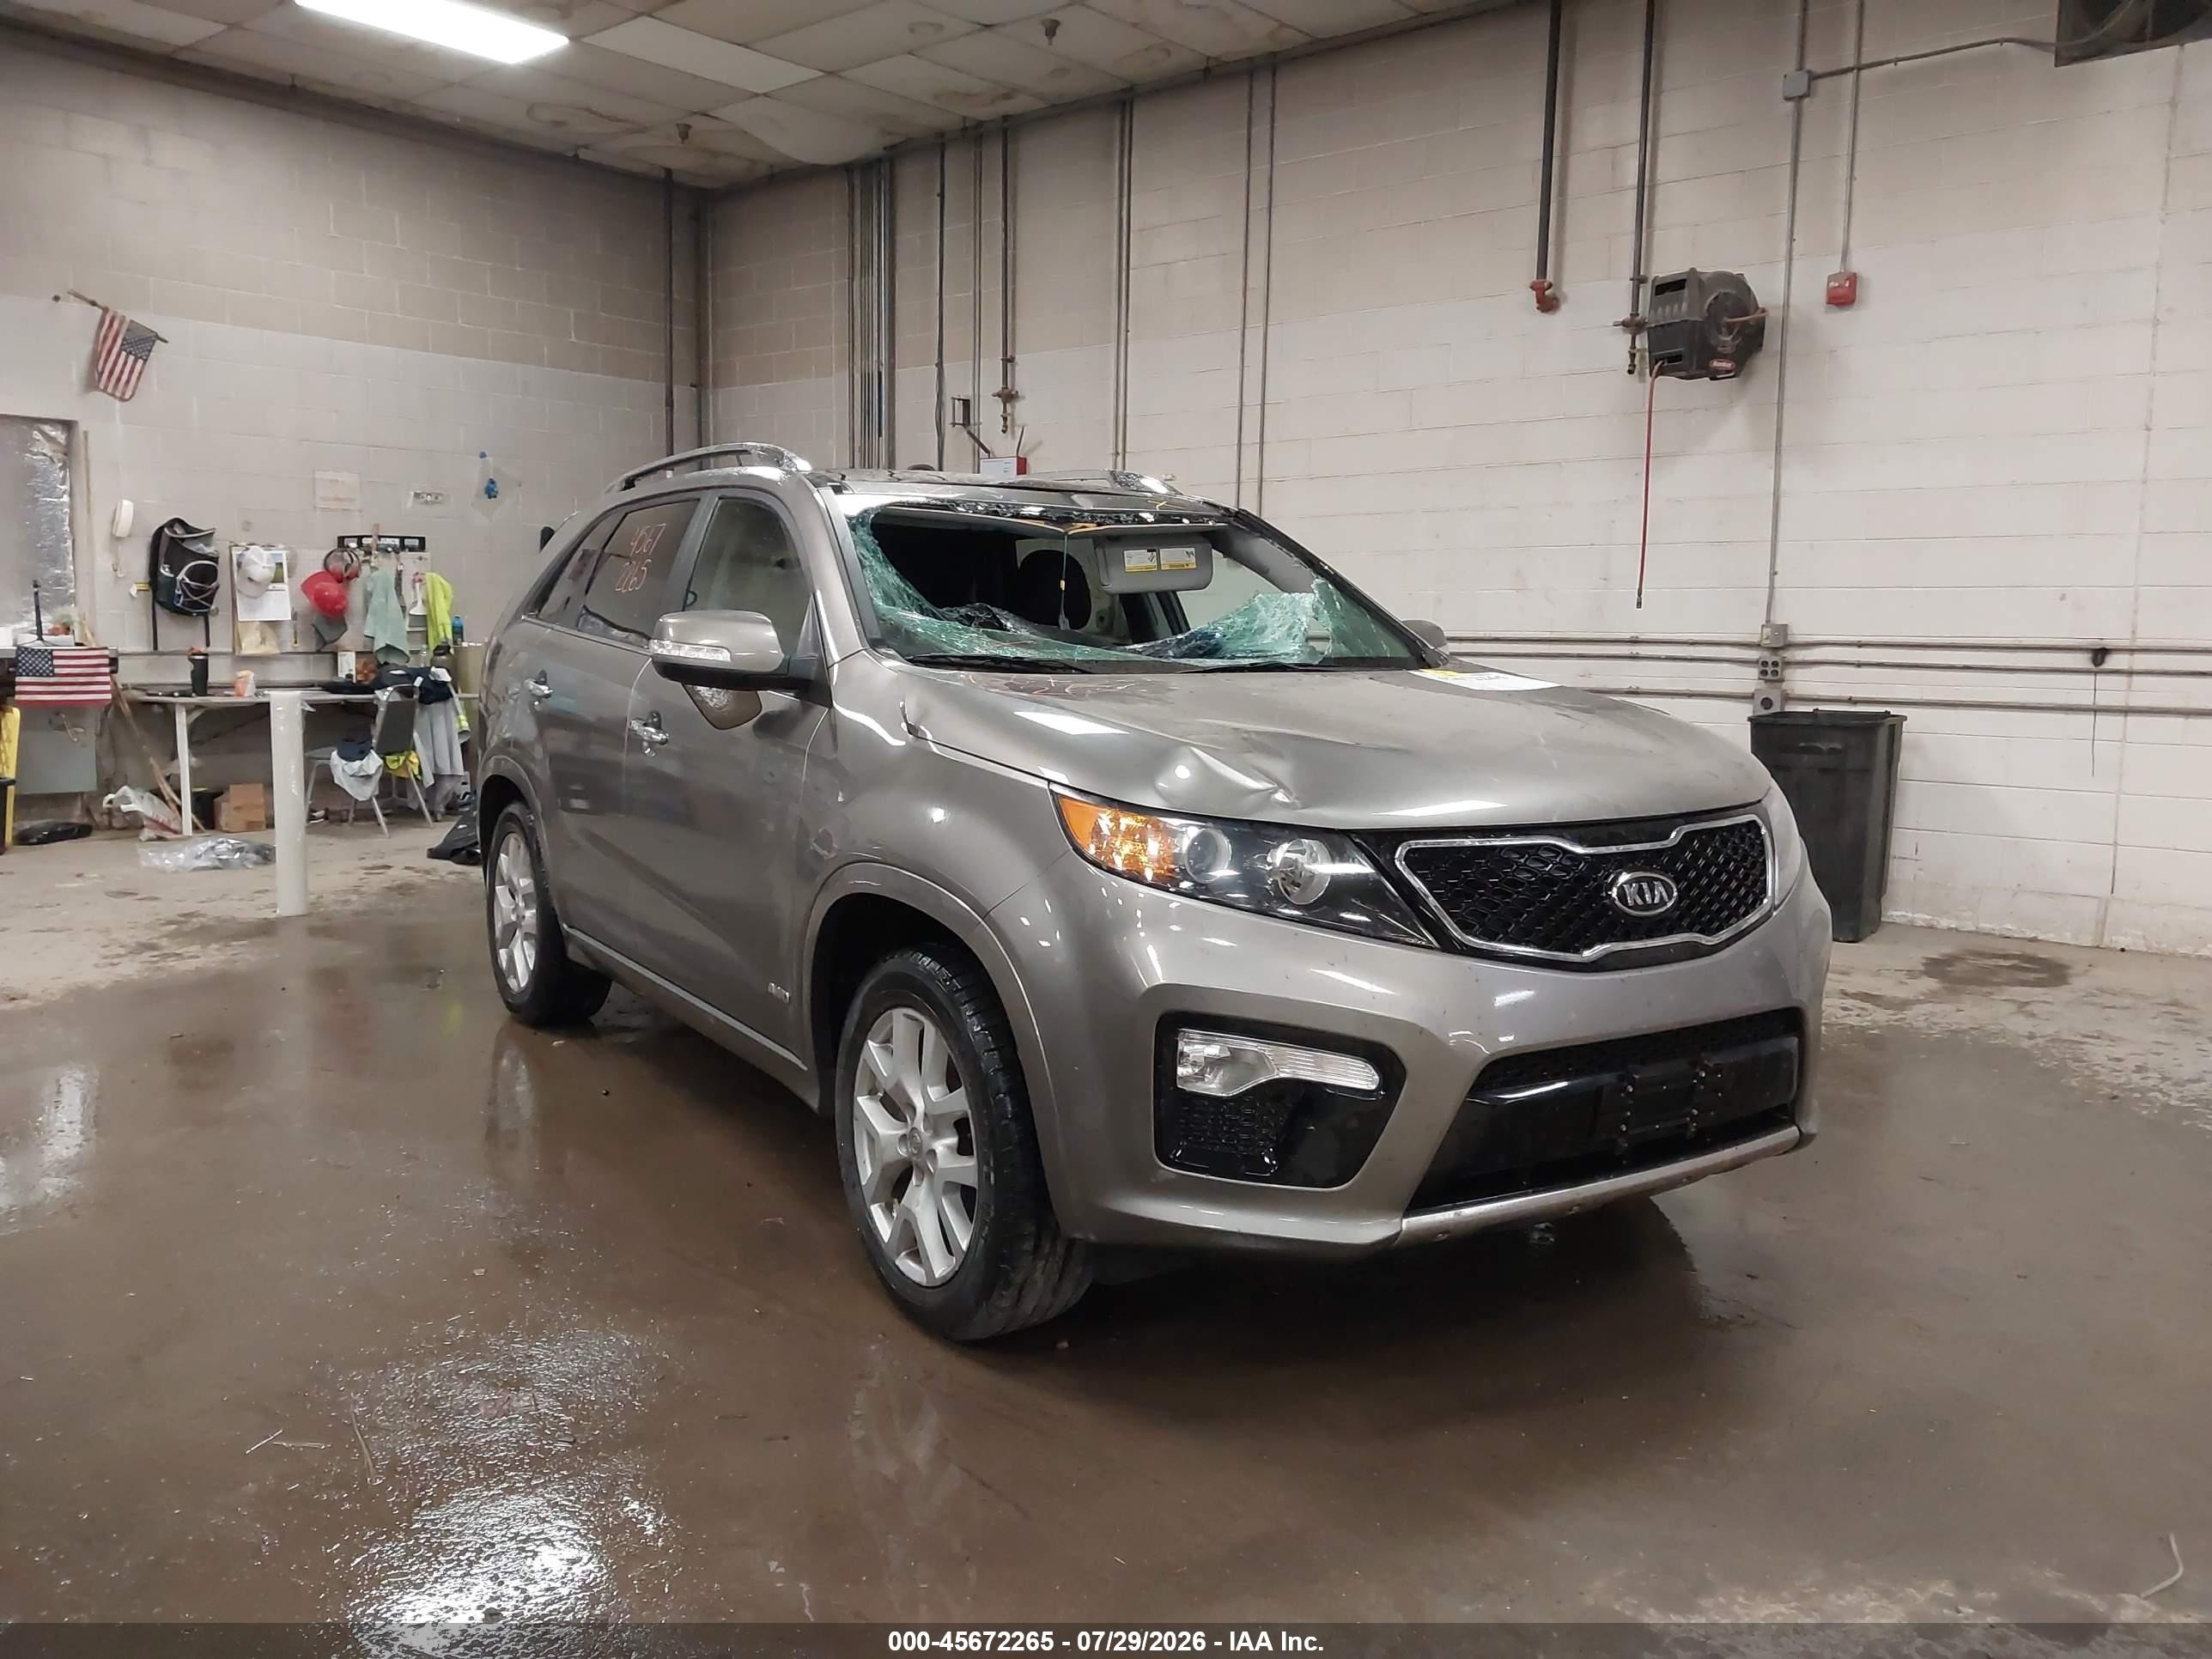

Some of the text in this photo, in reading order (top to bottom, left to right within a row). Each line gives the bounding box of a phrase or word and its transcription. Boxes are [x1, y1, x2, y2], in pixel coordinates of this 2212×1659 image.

[629, 522, 667, 557] 4567
[614, 558, 653, 593] 2265
[1621, 879, 1670, 907] KIA
